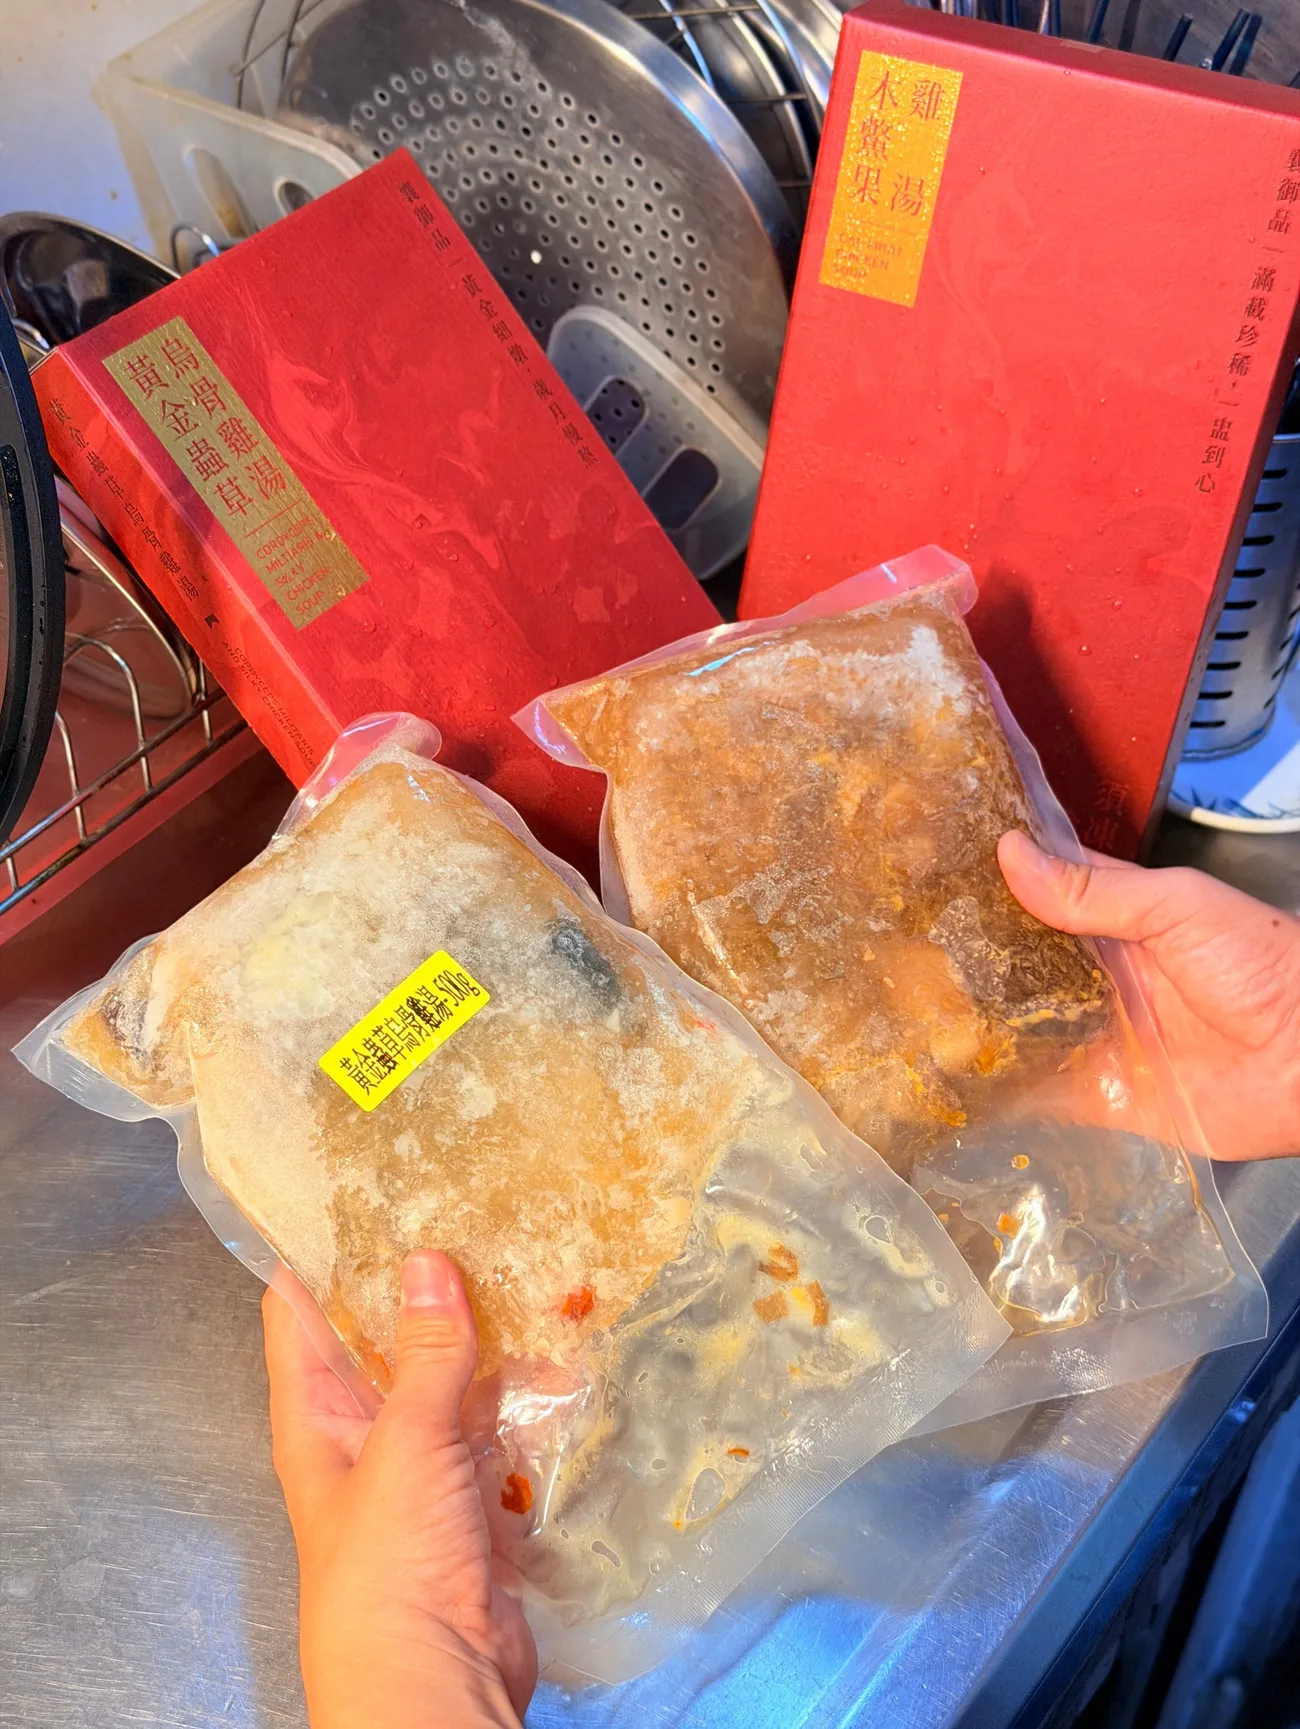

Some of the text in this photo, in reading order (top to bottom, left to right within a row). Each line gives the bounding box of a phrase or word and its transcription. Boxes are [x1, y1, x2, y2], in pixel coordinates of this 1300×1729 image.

[890, 79, 945, 216] 雞湯
[124, 353, 253, 517] 黃金蟲草
[160, 337, 288, 500] 烏骨雞湯
[285, 566, 330, 601] CHICKEN
[295, 590, 324, 614] SOUP
[222, 641, 240, 664] AND
[262, 696, 295, 739] CHICKEN
[234, 647, 278, 705] CORDYCEPS
